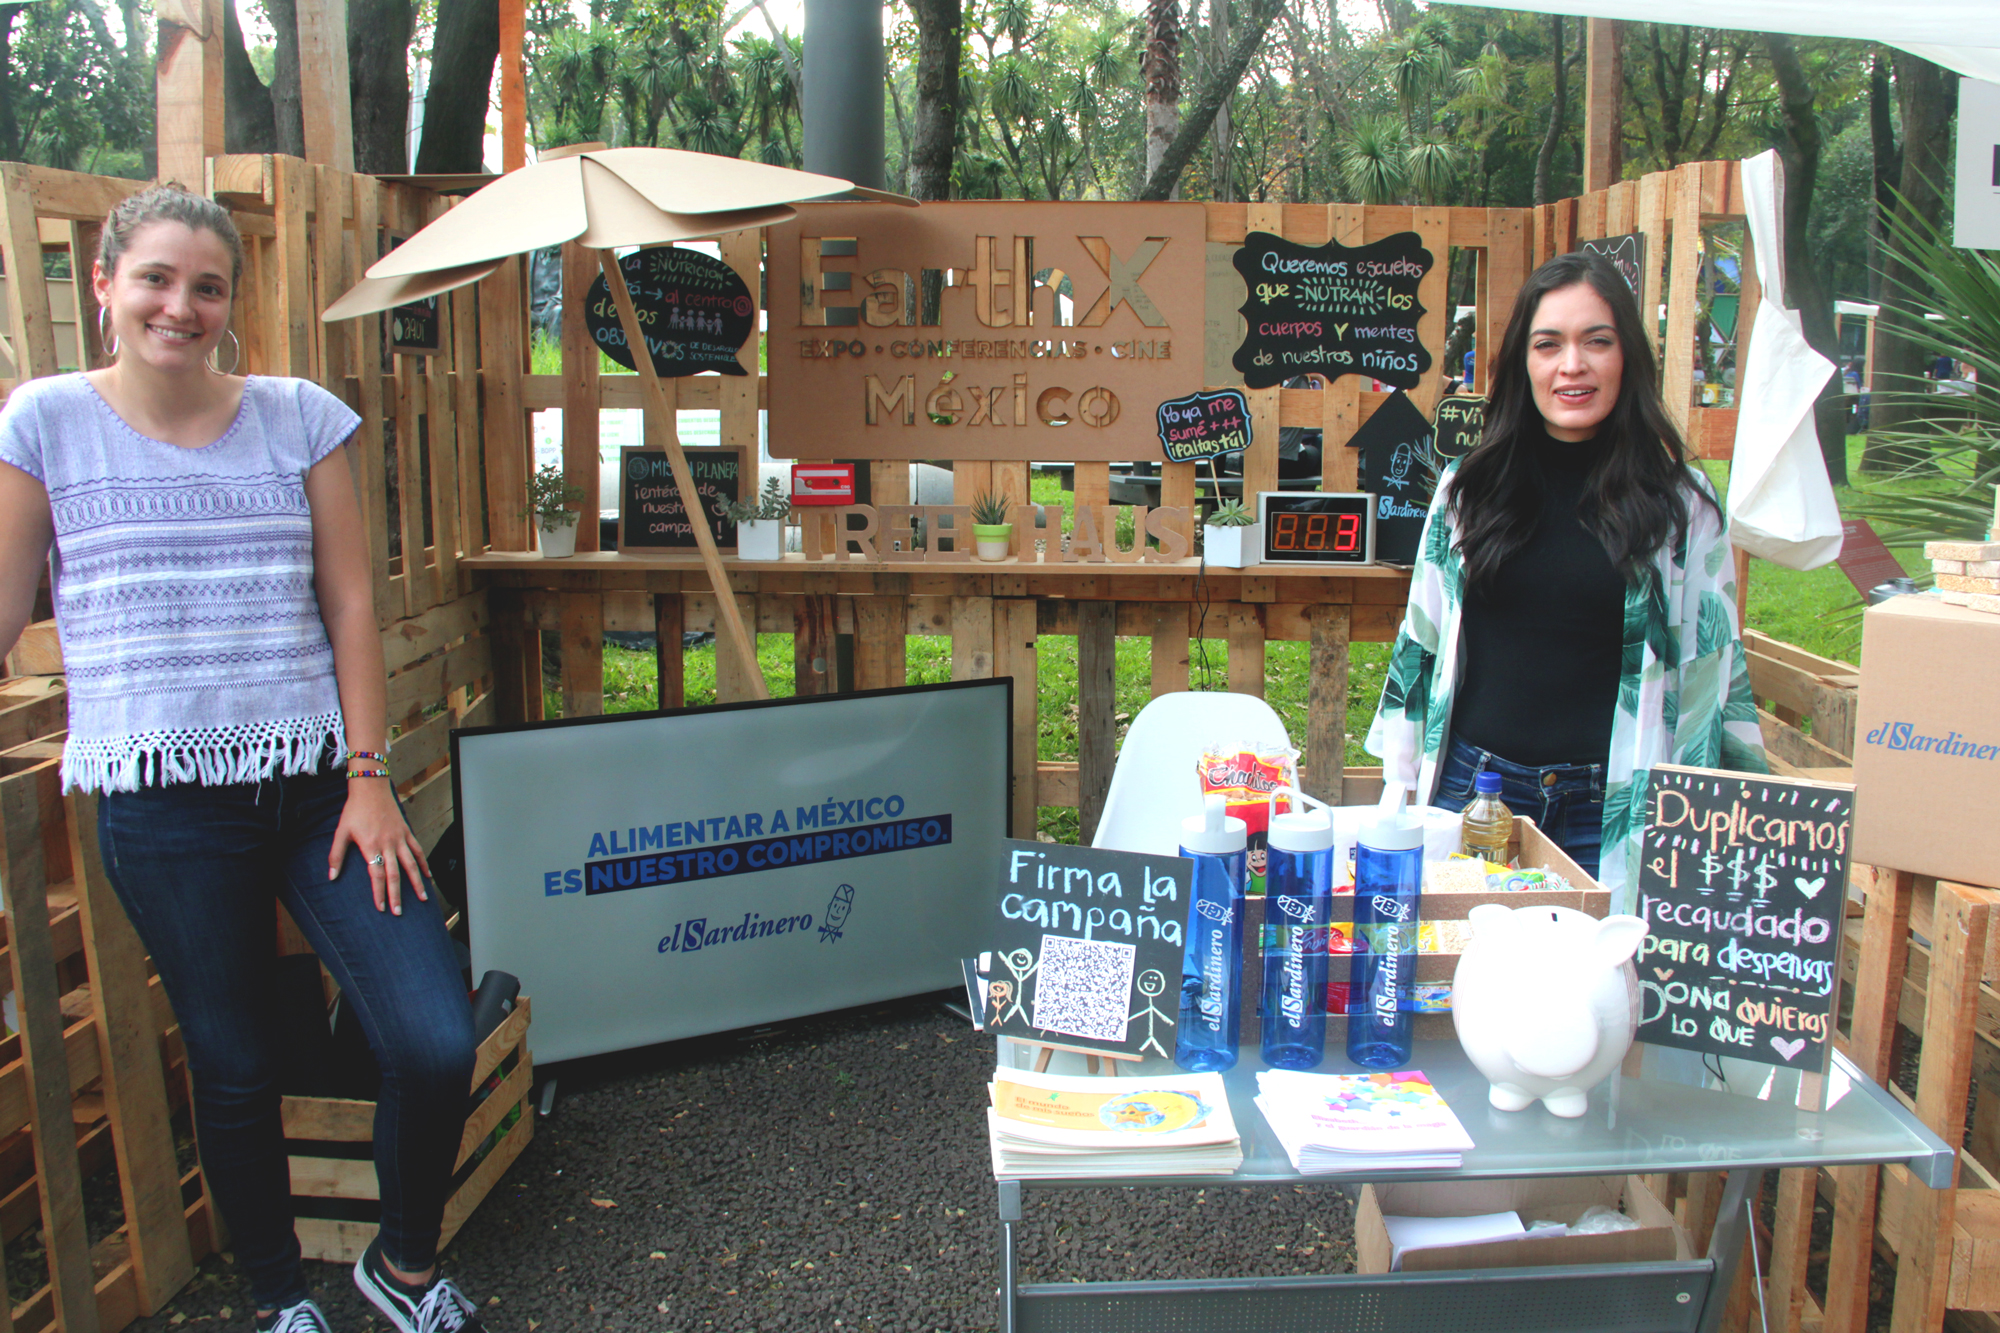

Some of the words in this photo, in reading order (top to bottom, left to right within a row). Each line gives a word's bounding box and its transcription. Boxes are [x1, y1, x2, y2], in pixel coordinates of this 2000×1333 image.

[1261, 251, 1348, 277] Queremos
[1356, 256, 1423, 278] escuelas
[602, 278, 642, 295] etá
[665, 289, 679, 305] al
[685, 292, 732, 308] centro
[800, 236, 1171, 328] EarthX
[593, 297, 617, 318] de
[1256, 283, 1290, 305] que
[1304, 285, 1375, 305] NUTRAN
[1387, 286, 1414, 310] los
[1259, 320, 1323, 339] cuerpos
[1354, 324, 1415, 343] mentes
[801, 339, 866, 359] EXPO
[889, 339, 1087, 359] CONFERENCIAS
[1110, 339, 1171, 359] CINE
[1253, 349, 1274, 366] de
[1282, 344, 1354, 365] nuestros
[1362, 349, 1418, 371] niños
[865, 370, 1121, 428] México
[1207, 398, 1236, 416] me
[1169, 420, 1208, 442] sumé
[651, 459, 694, 478] MISN
[697, 460, 739, 481] PLANETA
[698, 482, 719, 498] de
[643, 501, 687, 515] nuestr
[1377, 495, 1428, 520] Sardinero
[791, 503, 971, 562] TREE
[1017, 504, 1191, 563] HAUS
[587, 813, 764, 858] ALIMENTAR
[769, 807, 790, 834] A
[796, 794, 905, 832] MÉXICO
[543, 868, 583, 897] ES
[591, 846, 740, 892] NUESTRO
[746, 819, 949, 869] COMPROMISO.
[1646, 848, 1678, 889] el
[1009, 850, 1122, 898] Firma
[1641, 893, 1832, 947] recaudado
[1636, 933, 1711, 967] para
[1716, 937, 1834, 996] despensas
[1671, 1012, 1699, 1037] LO
[1709, 1015, 1756, 1047] QUE
[1028, 1100, 1070, 1111] mundo
[1032, 1106, 1053, 1114] mis
[1055, 1109, 1095, 1118] sueños
